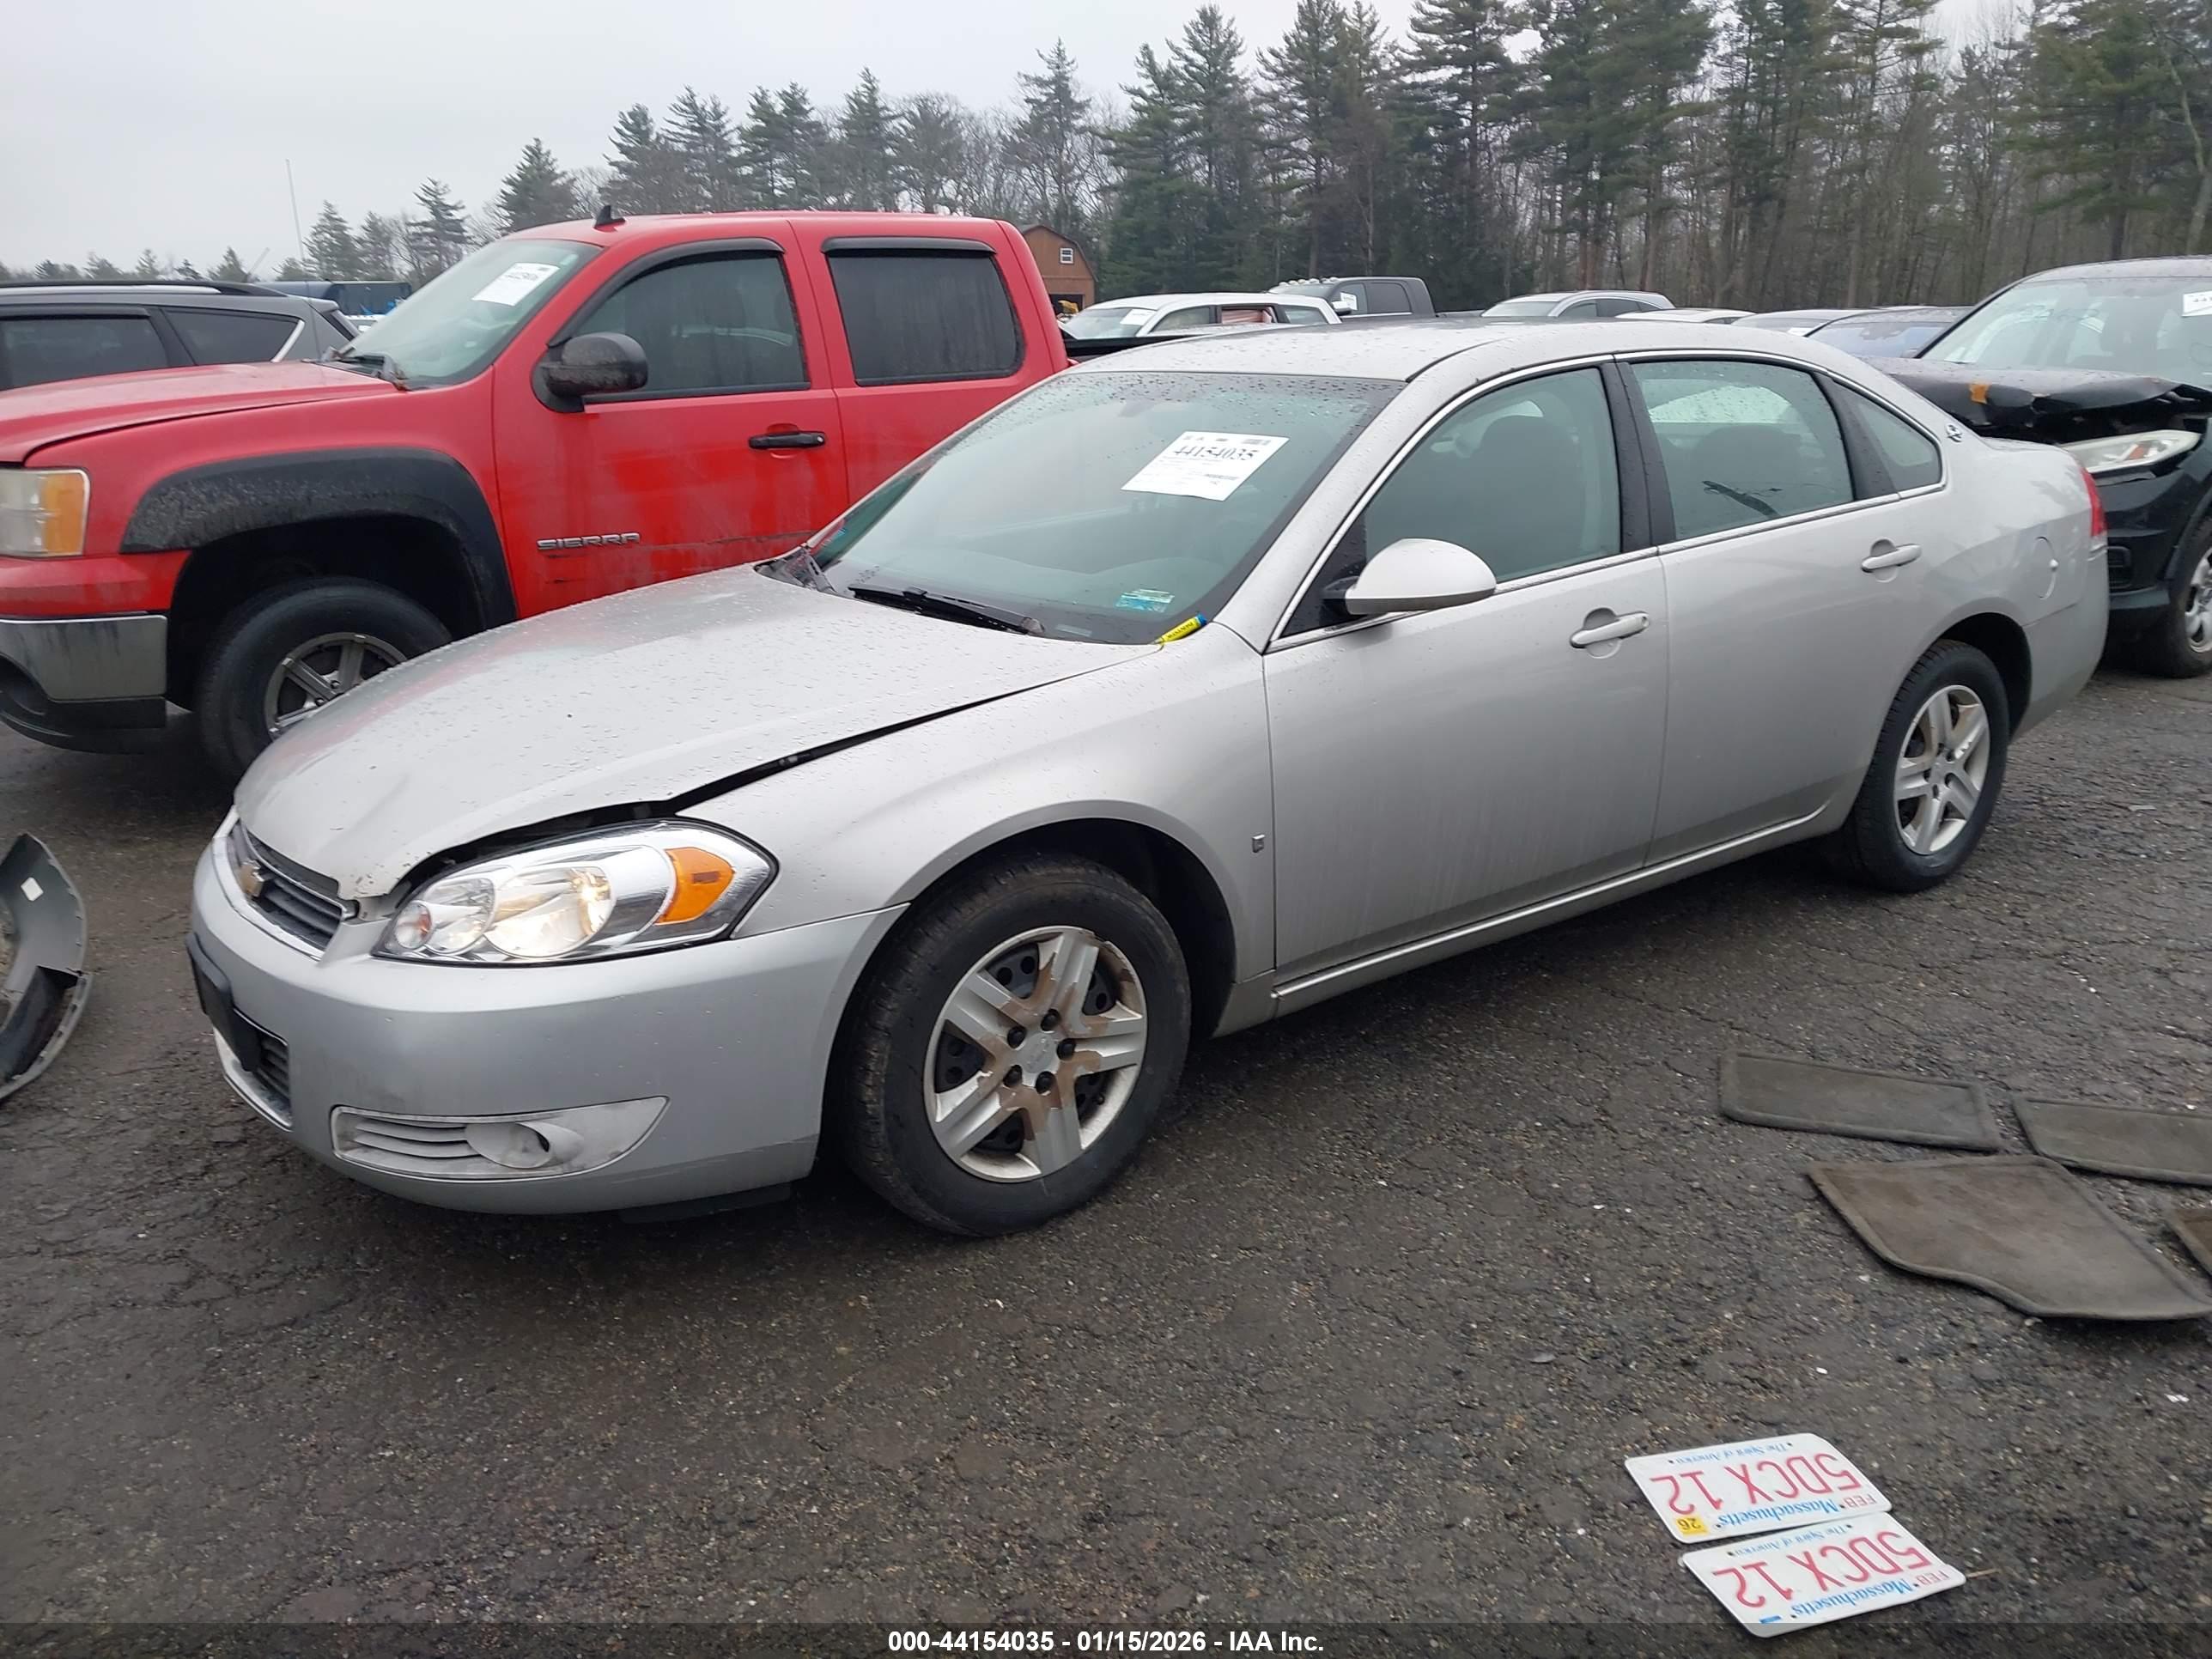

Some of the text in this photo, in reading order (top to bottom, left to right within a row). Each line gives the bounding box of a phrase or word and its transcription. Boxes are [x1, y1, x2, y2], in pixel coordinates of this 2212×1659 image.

[1174, 446, 1261, 461] 44154035
[537, 532, 641, 550] SIERRA
[1676, 1442, 1787, 1464] The Spirit of America
[1649, 1452, 1862, 1516] 5DCX 12
[1845, 1493, 1877, 1508] FEB
[1717, 1498, 1840, 1527] Massachusetts
[1677, 1517, 1701, 1531] 26
[1735, 1524, 1847, 1555] The Spirit of America
[1711, 1531, 1932, 1608] 5DCX 12
[1916, 1570, 1950, 1586] FEB
[1791, 1577, 1914, 1616] Massachusetts
